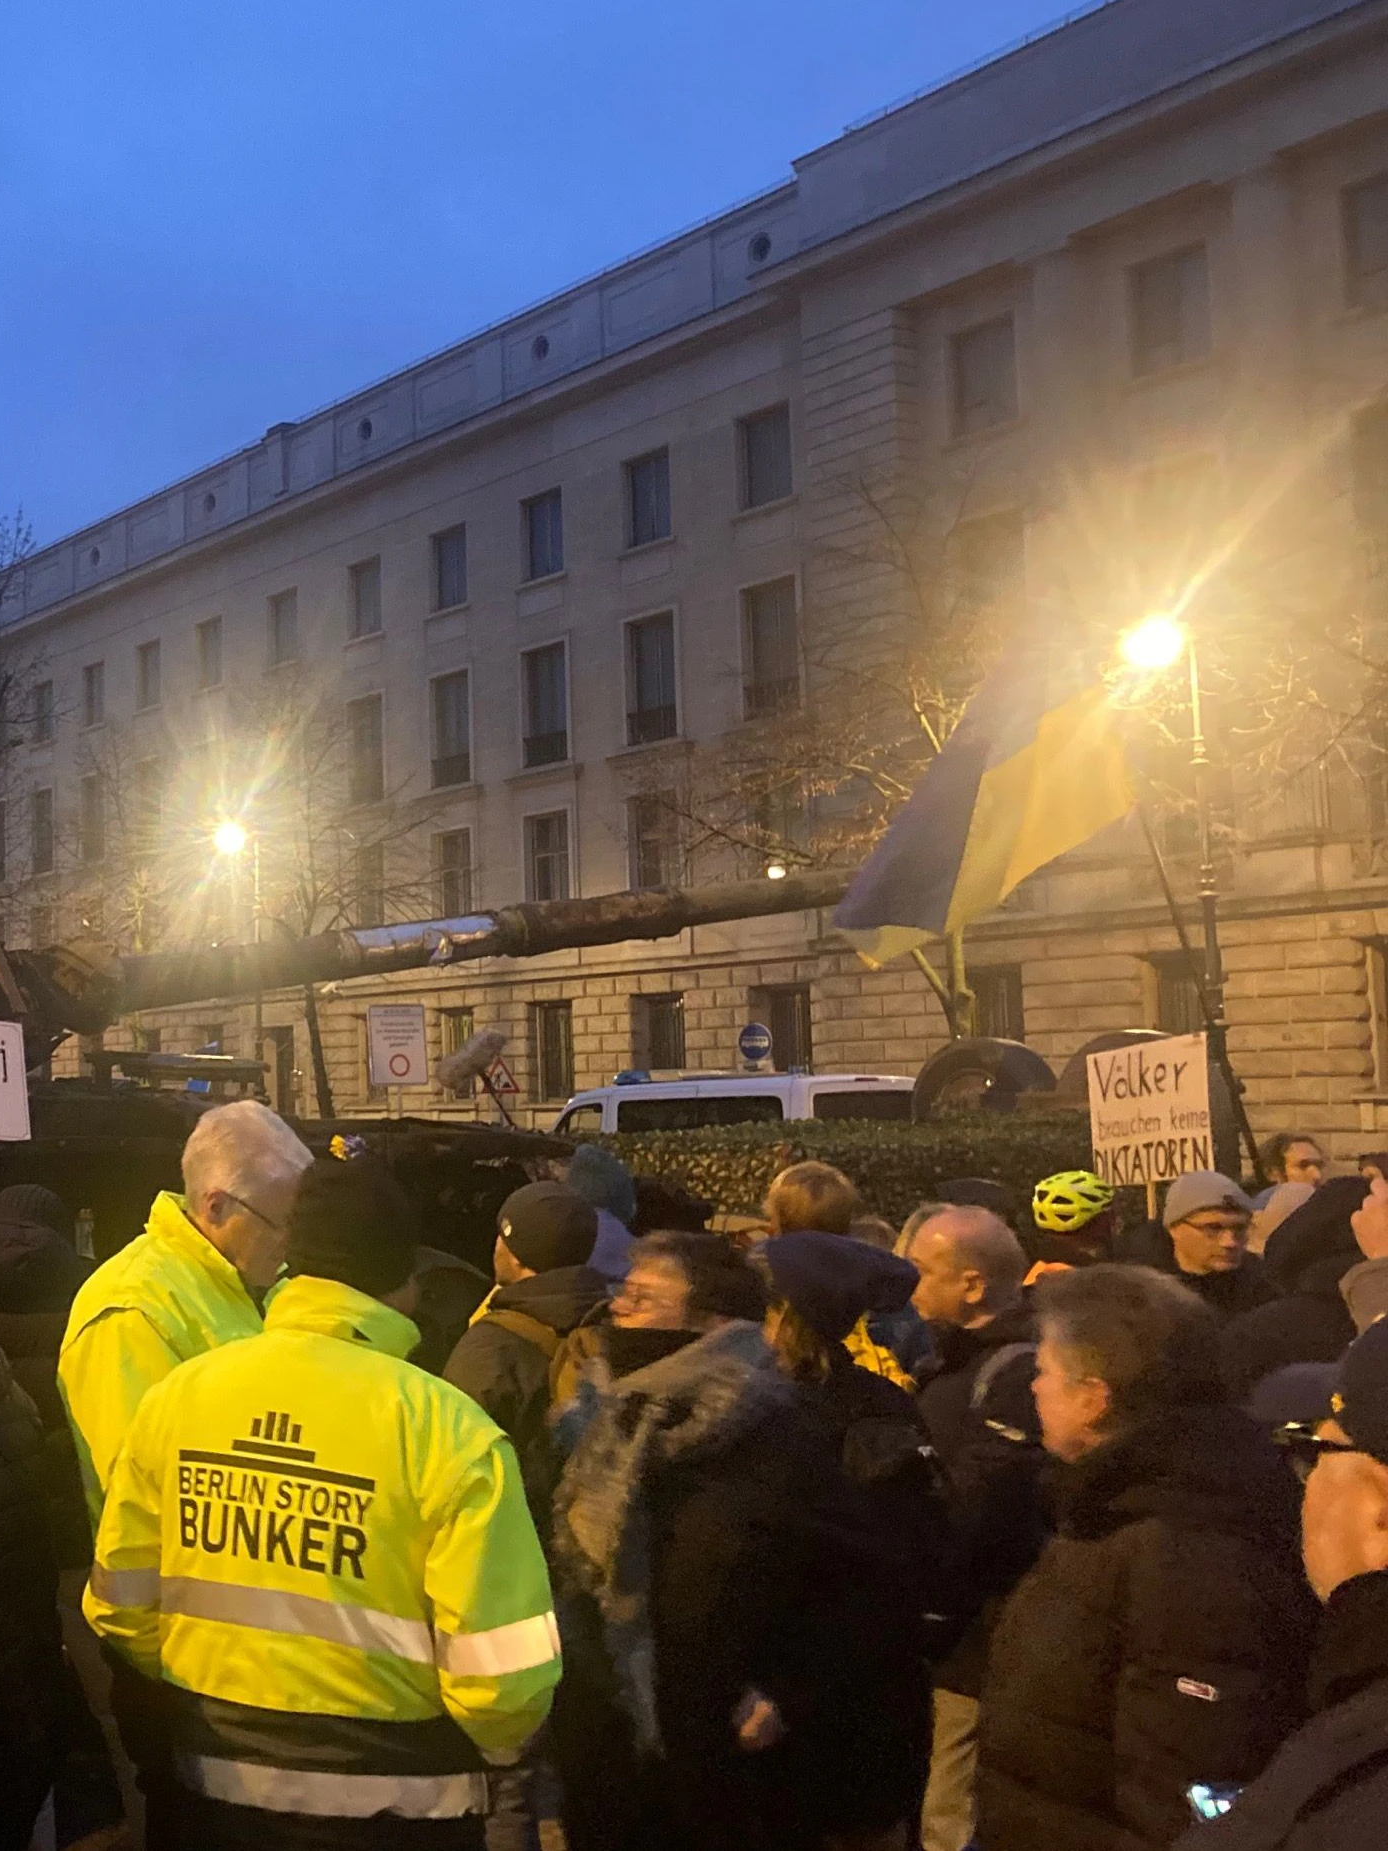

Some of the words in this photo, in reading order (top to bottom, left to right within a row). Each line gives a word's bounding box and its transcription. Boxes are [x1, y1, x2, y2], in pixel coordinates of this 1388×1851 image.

[178, 1466, 267, 1506] BERLIN
[275, 1480, 373, 1525] STORY
[179, 1497, 368, 1580] BUNKER
